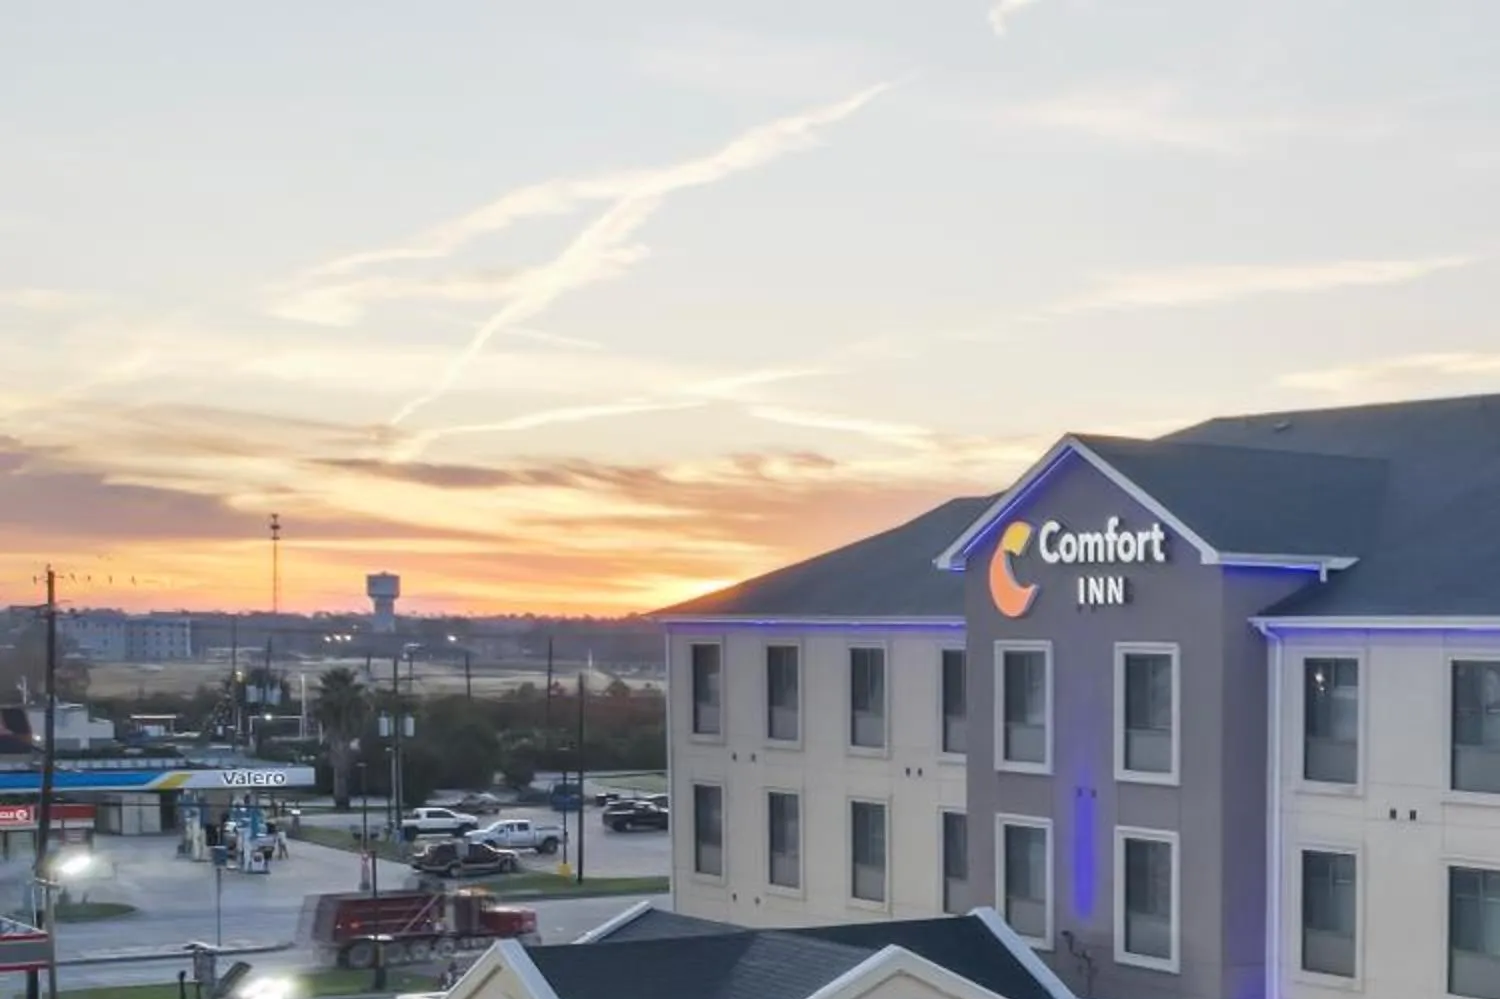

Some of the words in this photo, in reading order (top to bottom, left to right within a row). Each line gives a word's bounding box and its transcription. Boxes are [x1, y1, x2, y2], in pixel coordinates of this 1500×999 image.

[1039, 516, 1166, 564] Comfort
[1077, 576, 1125, 605] INN
[223, 771, 286, 785] Valero
